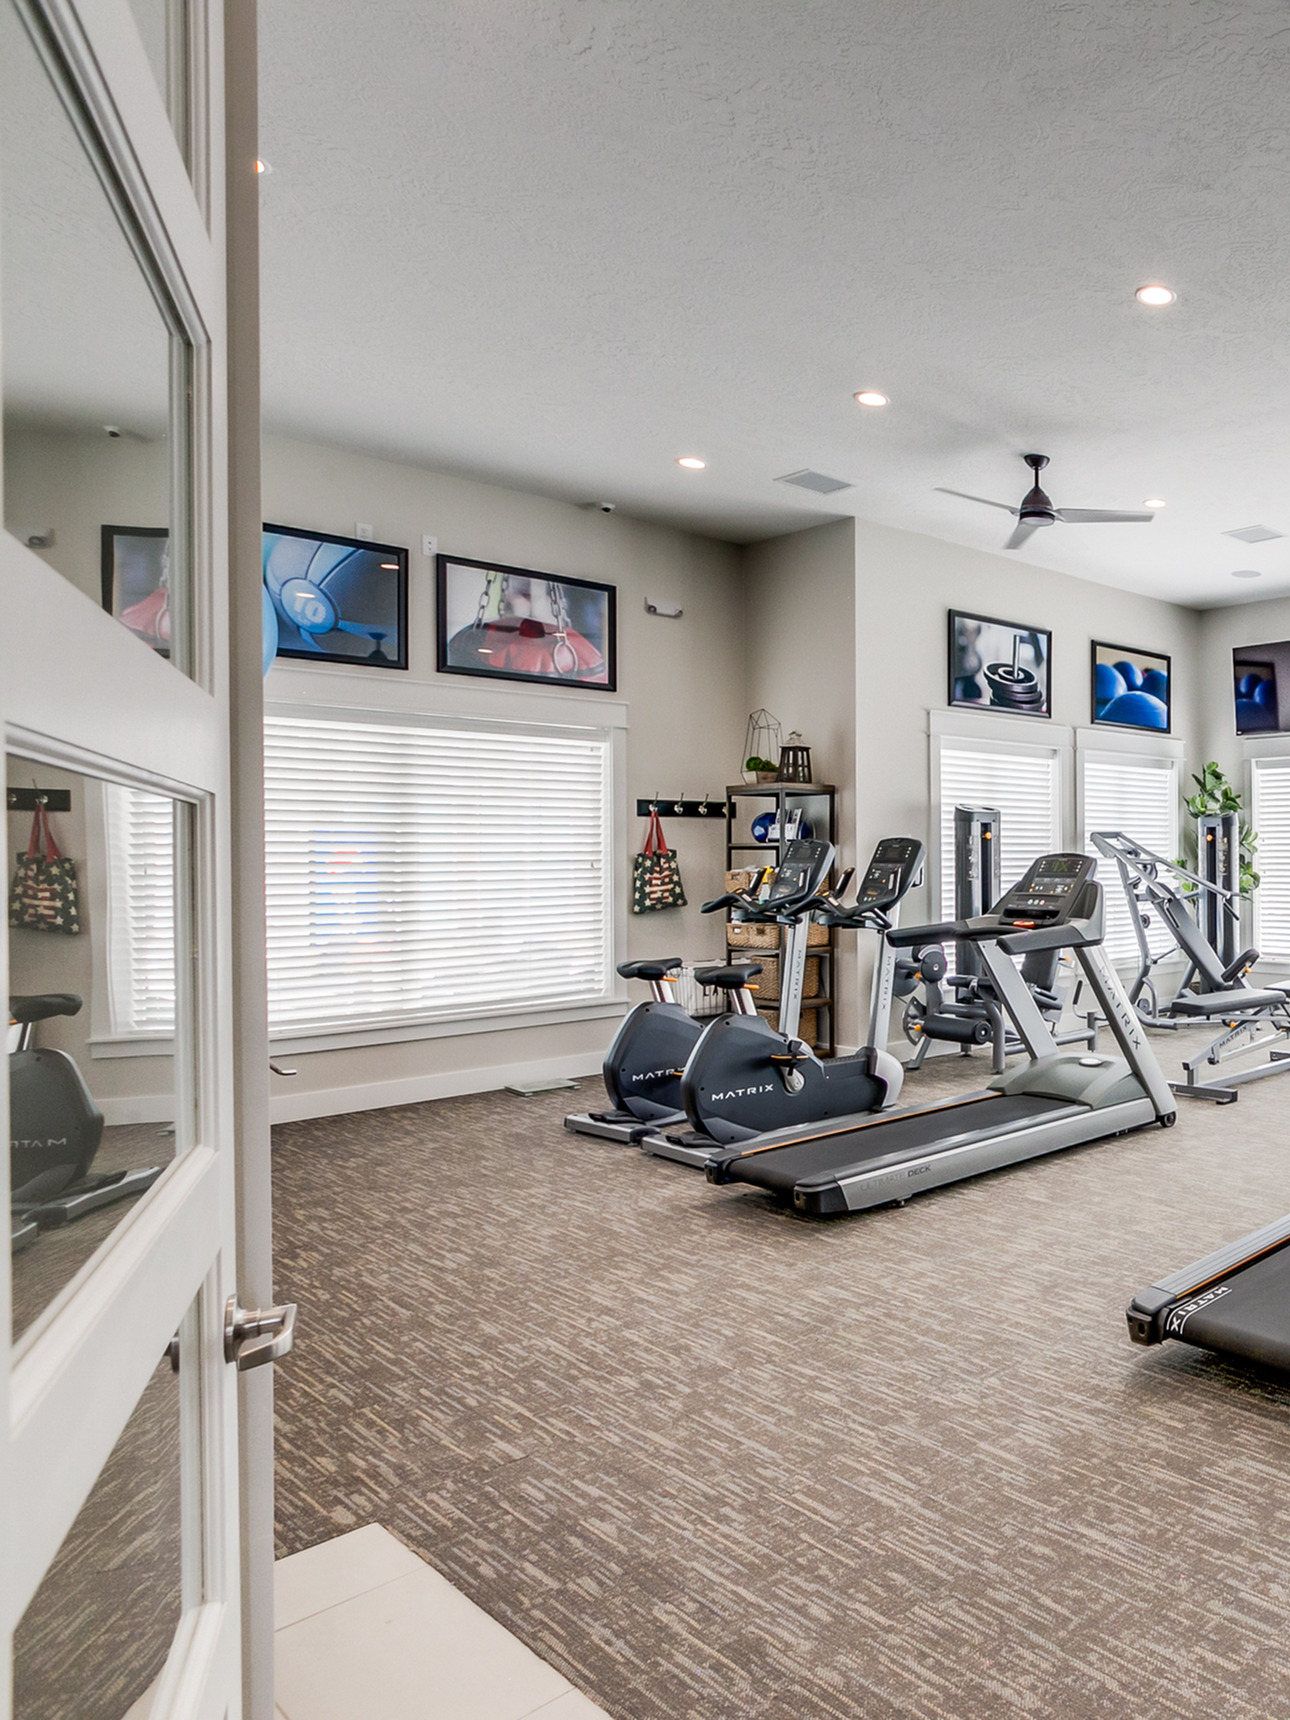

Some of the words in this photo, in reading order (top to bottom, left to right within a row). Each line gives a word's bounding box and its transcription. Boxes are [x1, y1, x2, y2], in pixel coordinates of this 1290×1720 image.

[1100, 966, 1141, 1050] MATRIX
[1219, 1025, 1247, 1048] MATRIX
[632, 1067, 685, 1082] MATR
[711, 1083, 774, 1101] MATRIX
[907, 1165, 931, 1178] DECK
[1170, 1286, 1229, 1332] MATRIX
